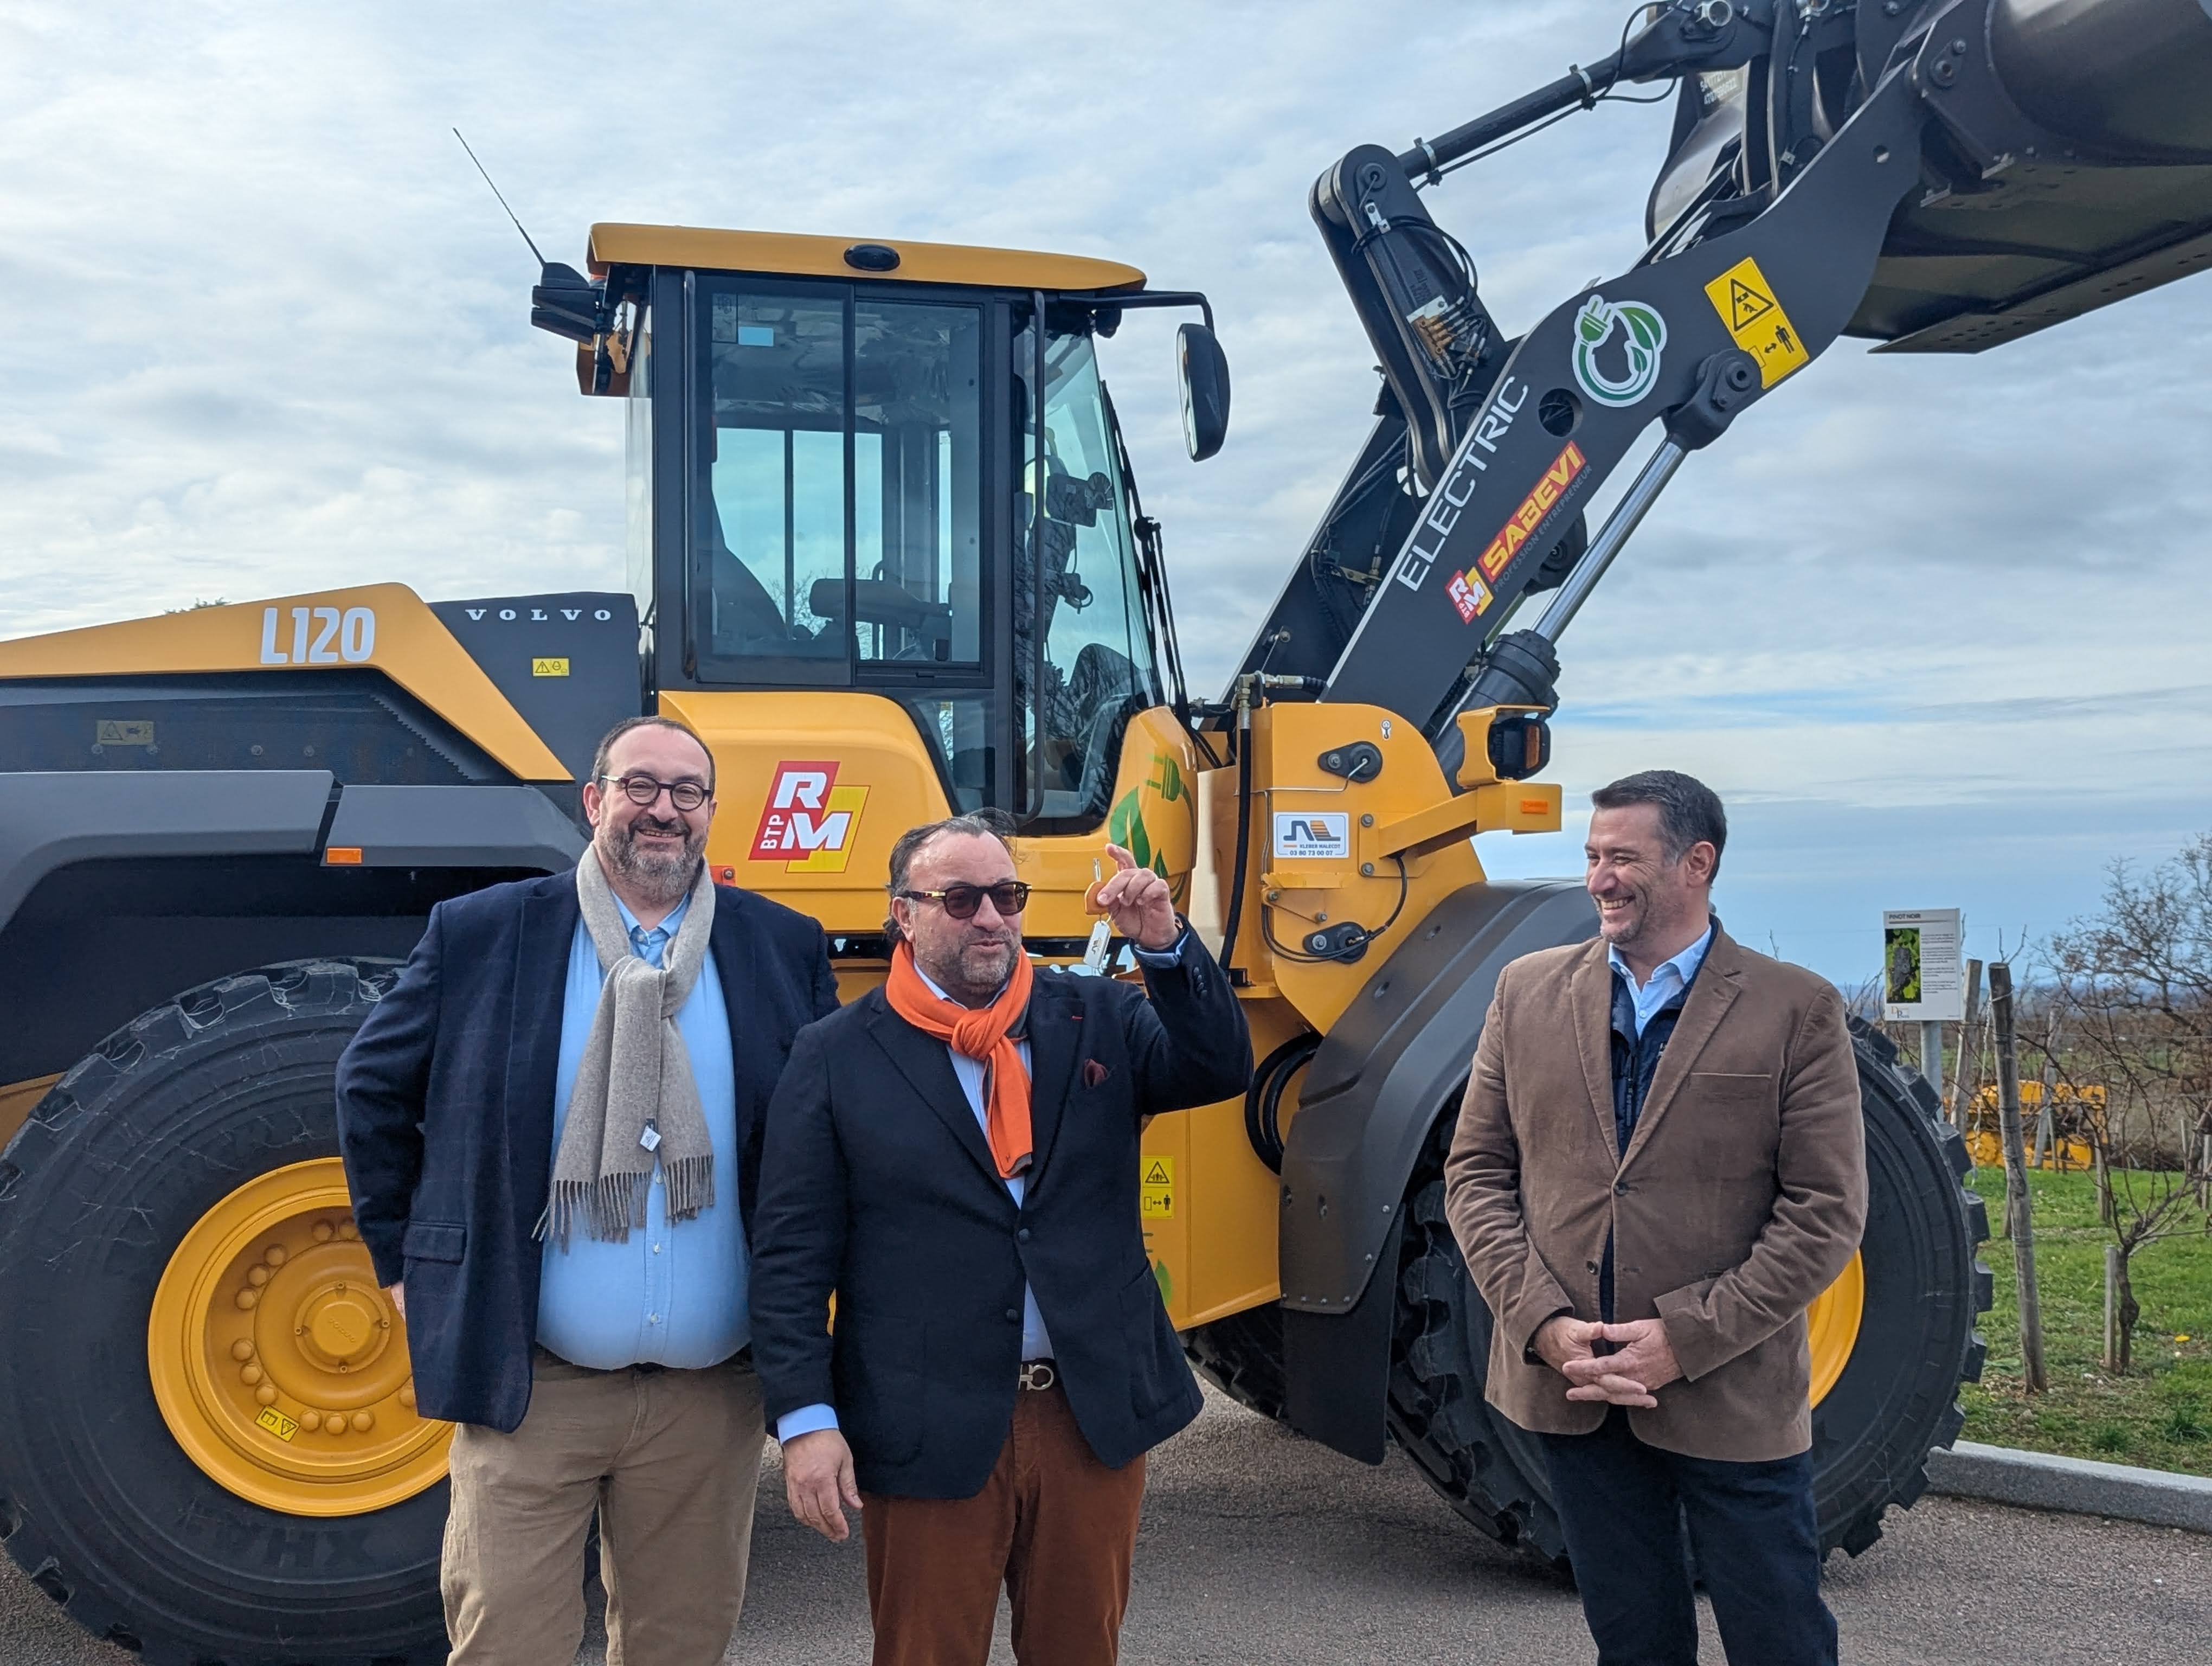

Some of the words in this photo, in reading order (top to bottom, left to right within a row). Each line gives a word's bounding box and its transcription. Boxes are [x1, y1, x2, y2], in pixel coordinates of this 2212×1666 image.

[1397, 376, 1528, 591] ELECTRIC
[1483, 446, 1580, 576] SABEVI
[1494, 534, 1540, 593] PROFESSION
[1538, 465, 1592, 535] ENTREPRENEUR
[260, 607, 375, 664] L120
[465, 608, 612, 621] VOLVO
[760, 814, 785, 849] BTP
